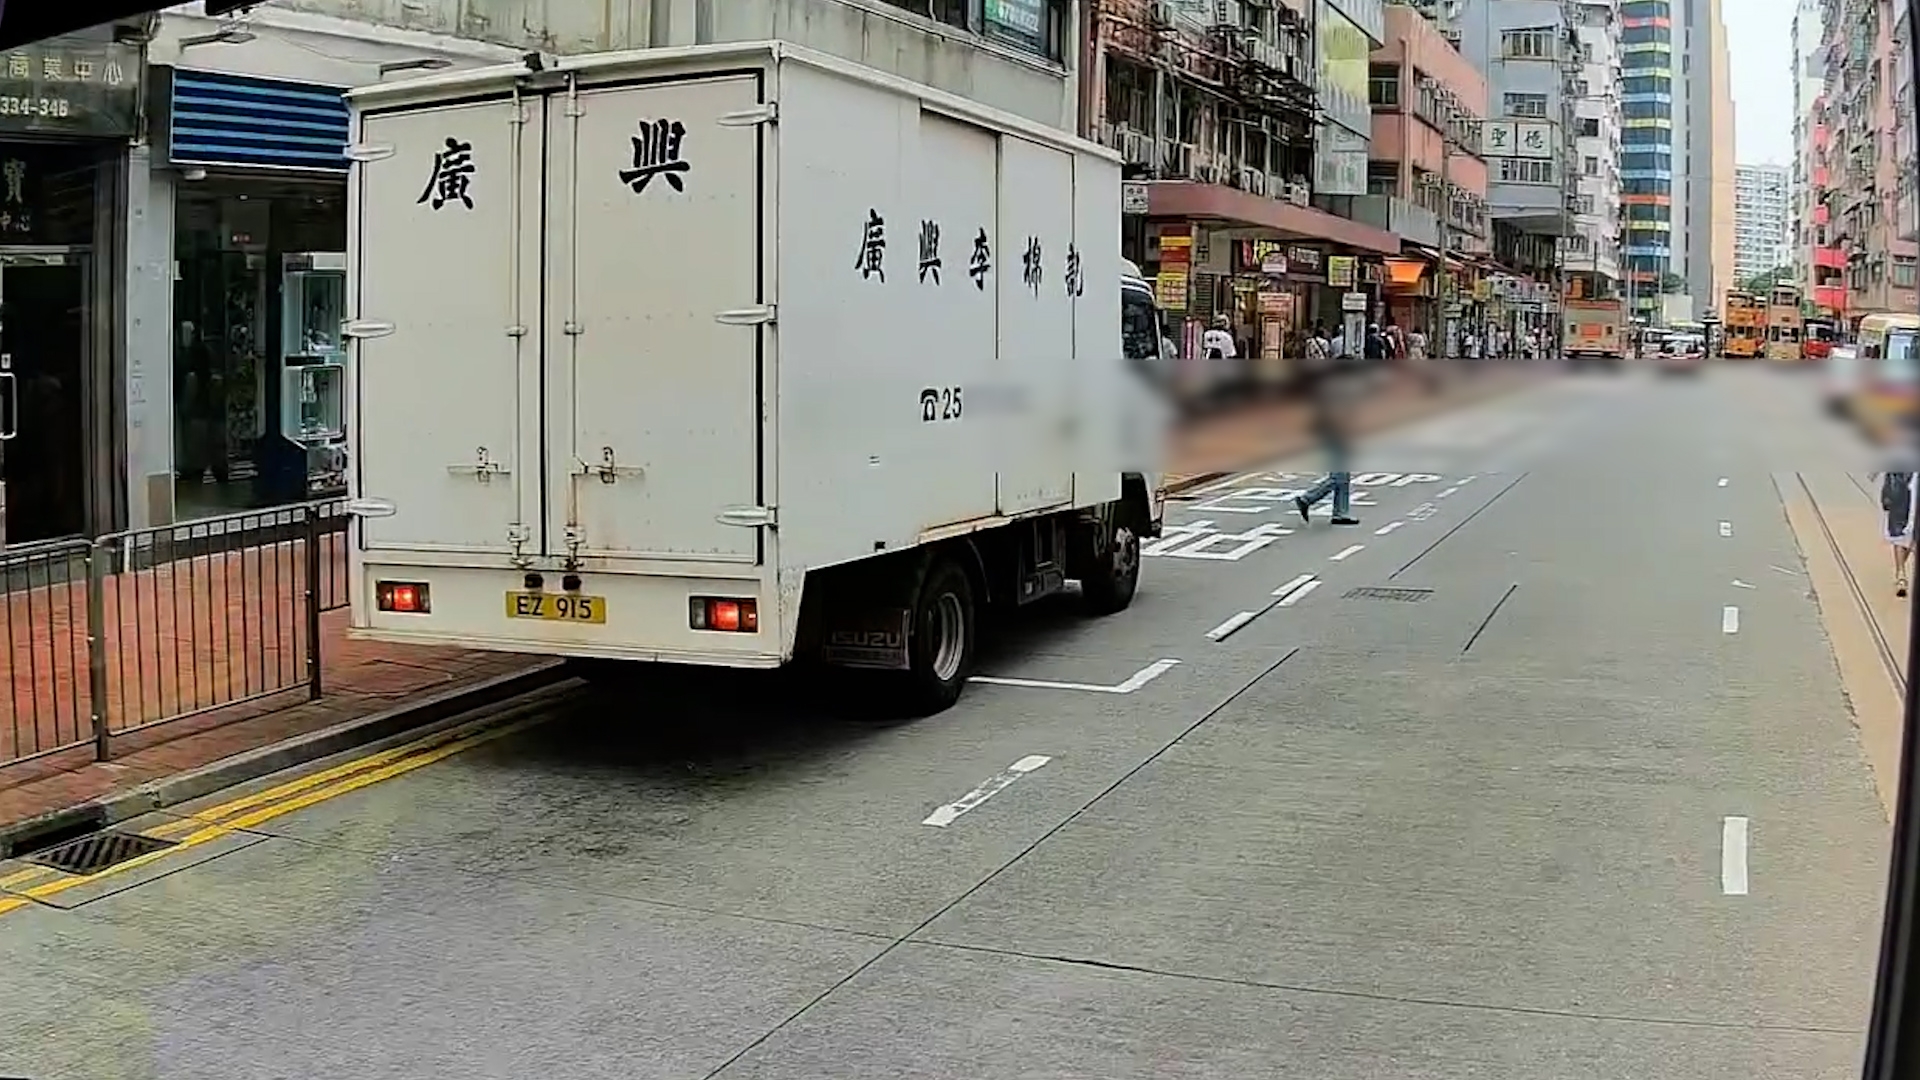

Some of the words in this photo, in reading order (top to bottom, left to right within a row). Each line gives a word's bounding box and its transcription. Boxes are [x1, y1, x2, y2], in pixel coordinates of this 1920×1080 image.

[9, 51, 123, 86] 商業中心
[1491, 127, 1543, 149] 聖德
[517, 596, 543, 615] EZ
[557, 598, 591, 618] 915
[833, 631, 900, 646] ISUZU
